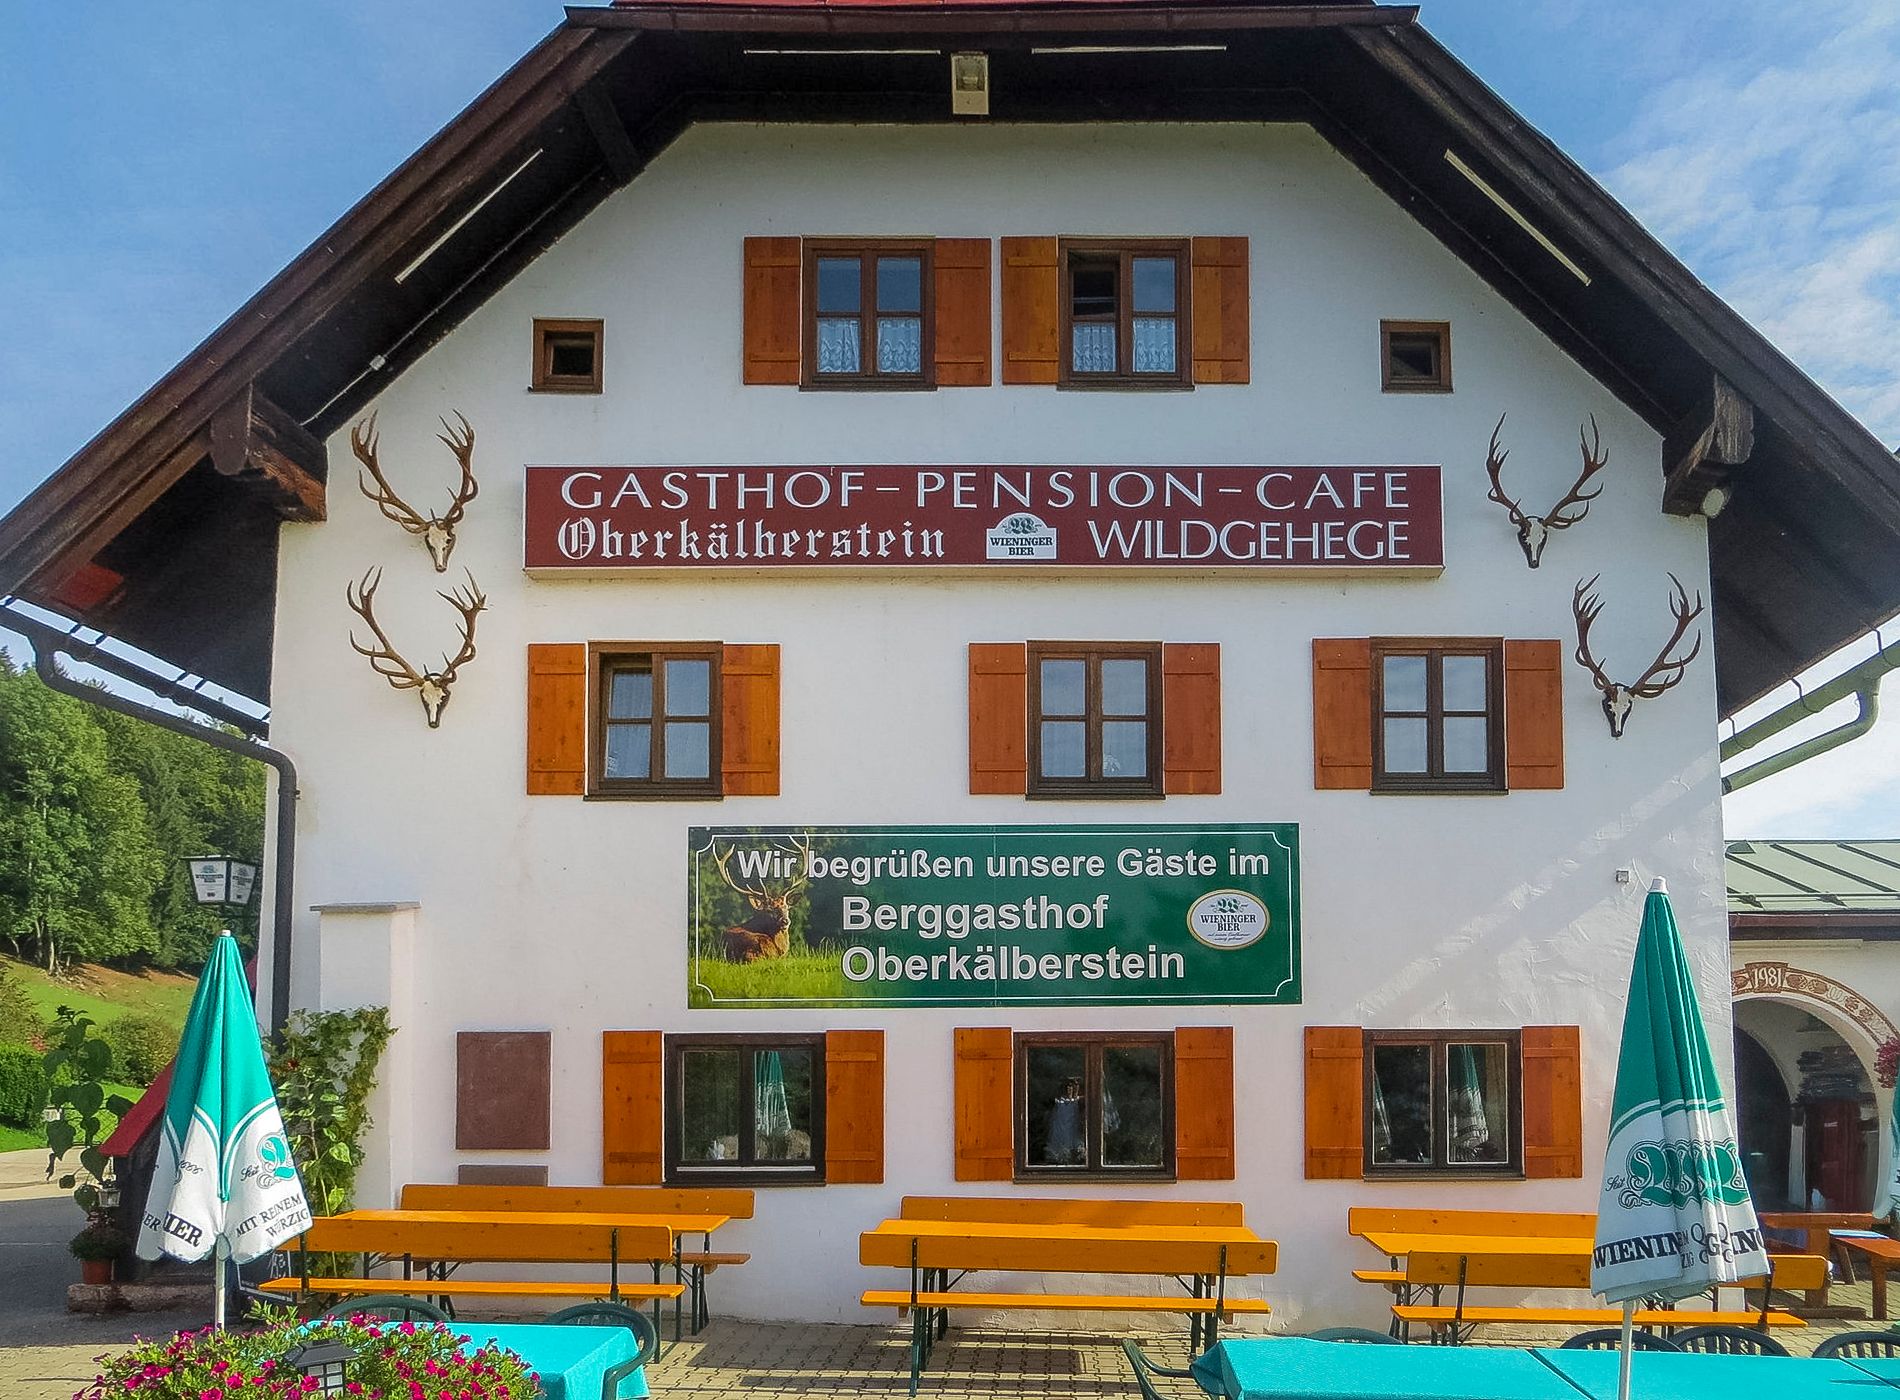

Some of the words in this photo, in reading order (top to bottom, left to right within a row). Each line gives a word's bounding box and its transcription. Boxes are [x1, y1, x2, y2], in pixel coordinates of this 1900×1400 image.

[1255, 471, 1410, 511] CAFE
[557, 515, 946, 560] Oberkälberstein
[989, 536, 1053, 546] WIENINGER
[1008, 546, 1035, 556] BIER
[1086, 519, 1411, 560] WILDGEHEGE
[737, 849, 798, 879] Wir
[808, 849, 974, 886] begrüßen
[986, 851, 1106, 878] unsere
[1116, 847, 1218, 877] Gäste
[1228, 847, 1270, 876] im
[841, 894, 1110, 939] Berggasthof
[1200, 914, 1256, 923] WIENINGER
[1217, 923, 1240, 931] BIER
[841, 944, 1186, 982] Oberkälberstein
[1752, 967, 1782, 988] 1981
[1604, 1174, 1626, 1192] Seit
[163, 1211, 203, 1247] IER
